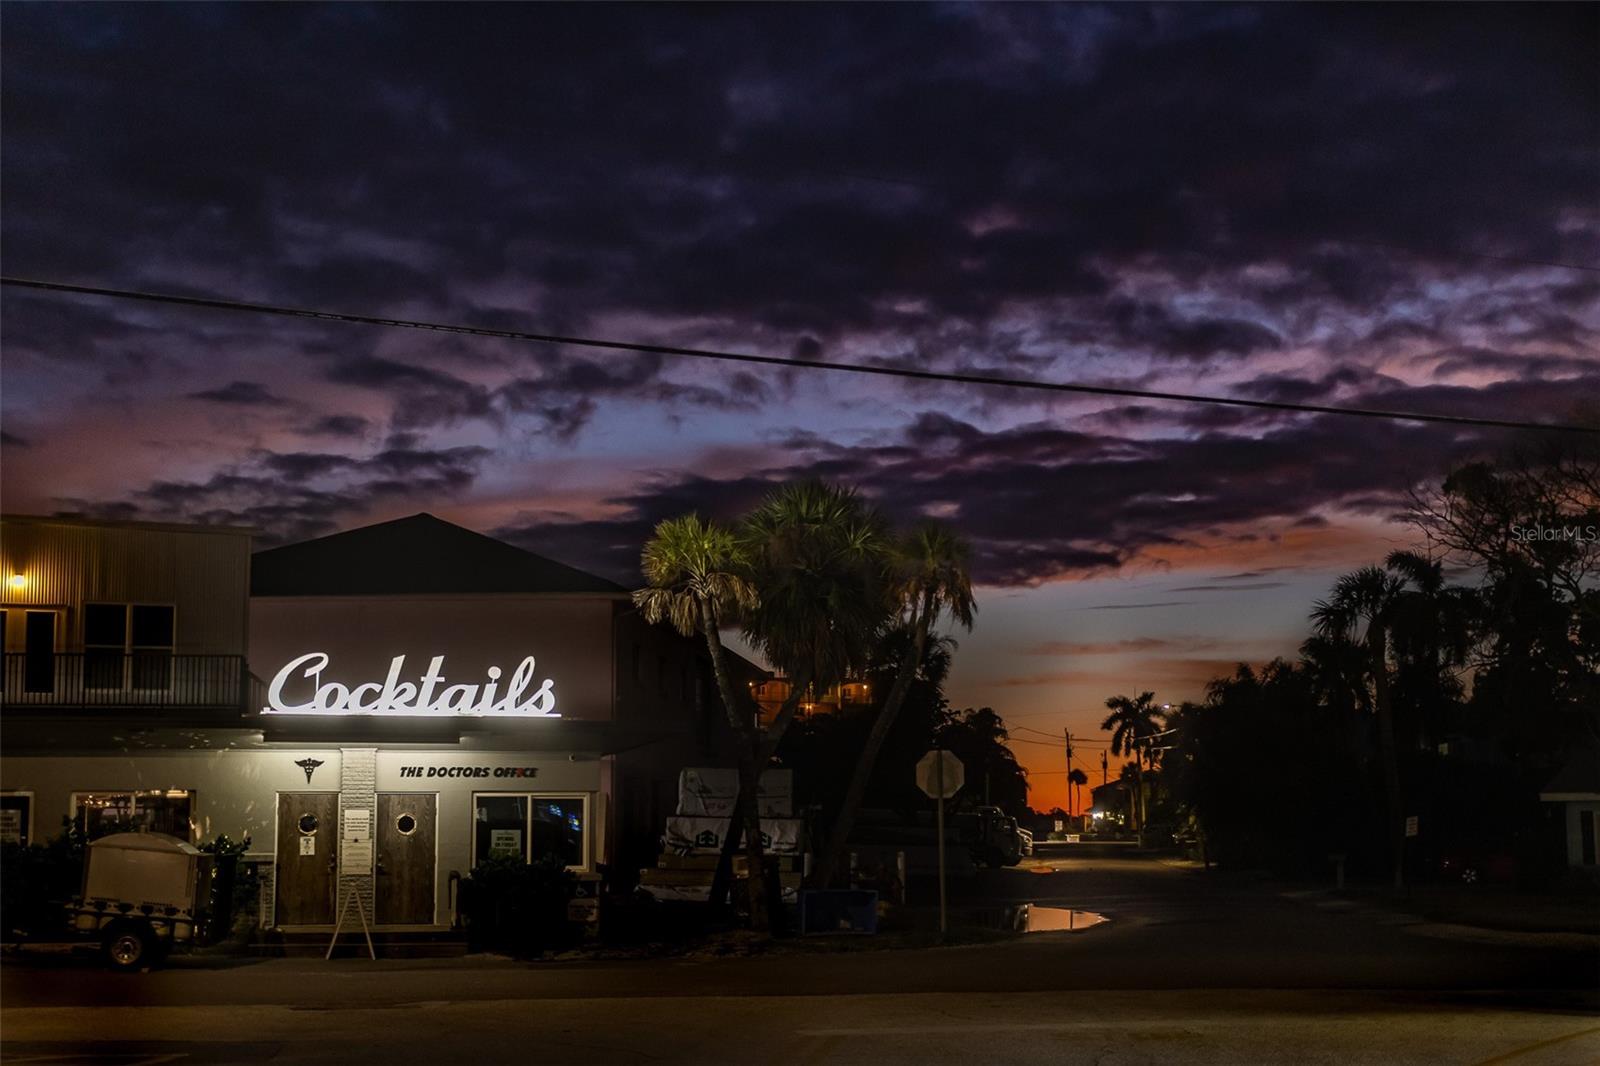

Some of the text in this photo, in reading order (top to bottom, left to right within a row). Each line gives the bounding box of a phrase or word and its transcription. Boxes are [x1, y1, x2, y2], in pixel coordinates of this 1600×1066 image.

[267, 652, 557, 715] Cocktails
[400, 766, 424, 778] THE
[427, 766, 490, 778] DOCTORS
